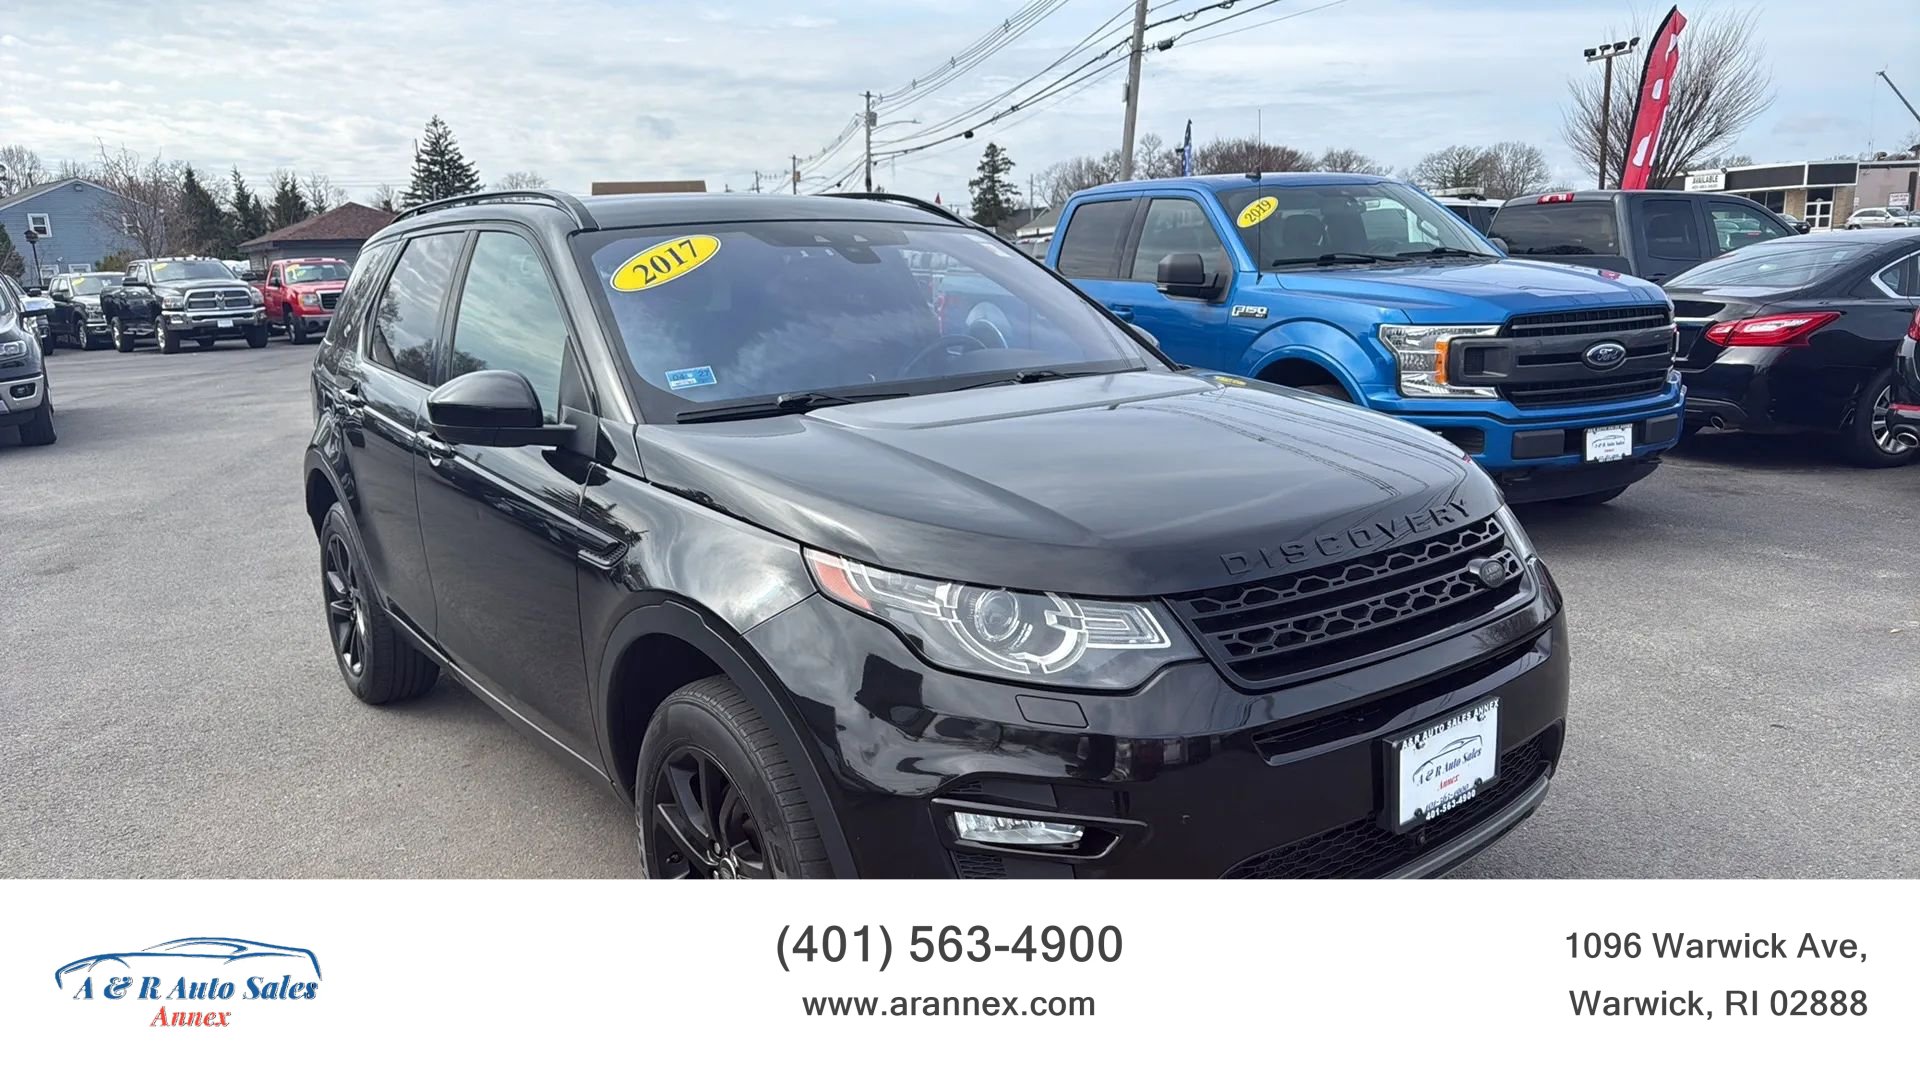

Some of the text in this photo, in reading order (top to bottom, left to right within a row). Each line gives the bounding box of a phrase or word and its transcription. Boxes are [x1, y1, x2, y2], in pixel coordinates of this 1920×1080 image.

[1244, 199, 1272, 223] 2019
[632, 238, 698, 285] 2017
[1220, 499, 1470, 575] DISCOVERY
[1402, 699, 1499, 749] A&R AUTO SALES ANNEX
[1435, 765, 1442, 778] R
[1445, 758, 1461, 772] Auto
[1463, 747, 1482, 762] Sales
[1425, 789, 1476, 821] 401-563-4900
